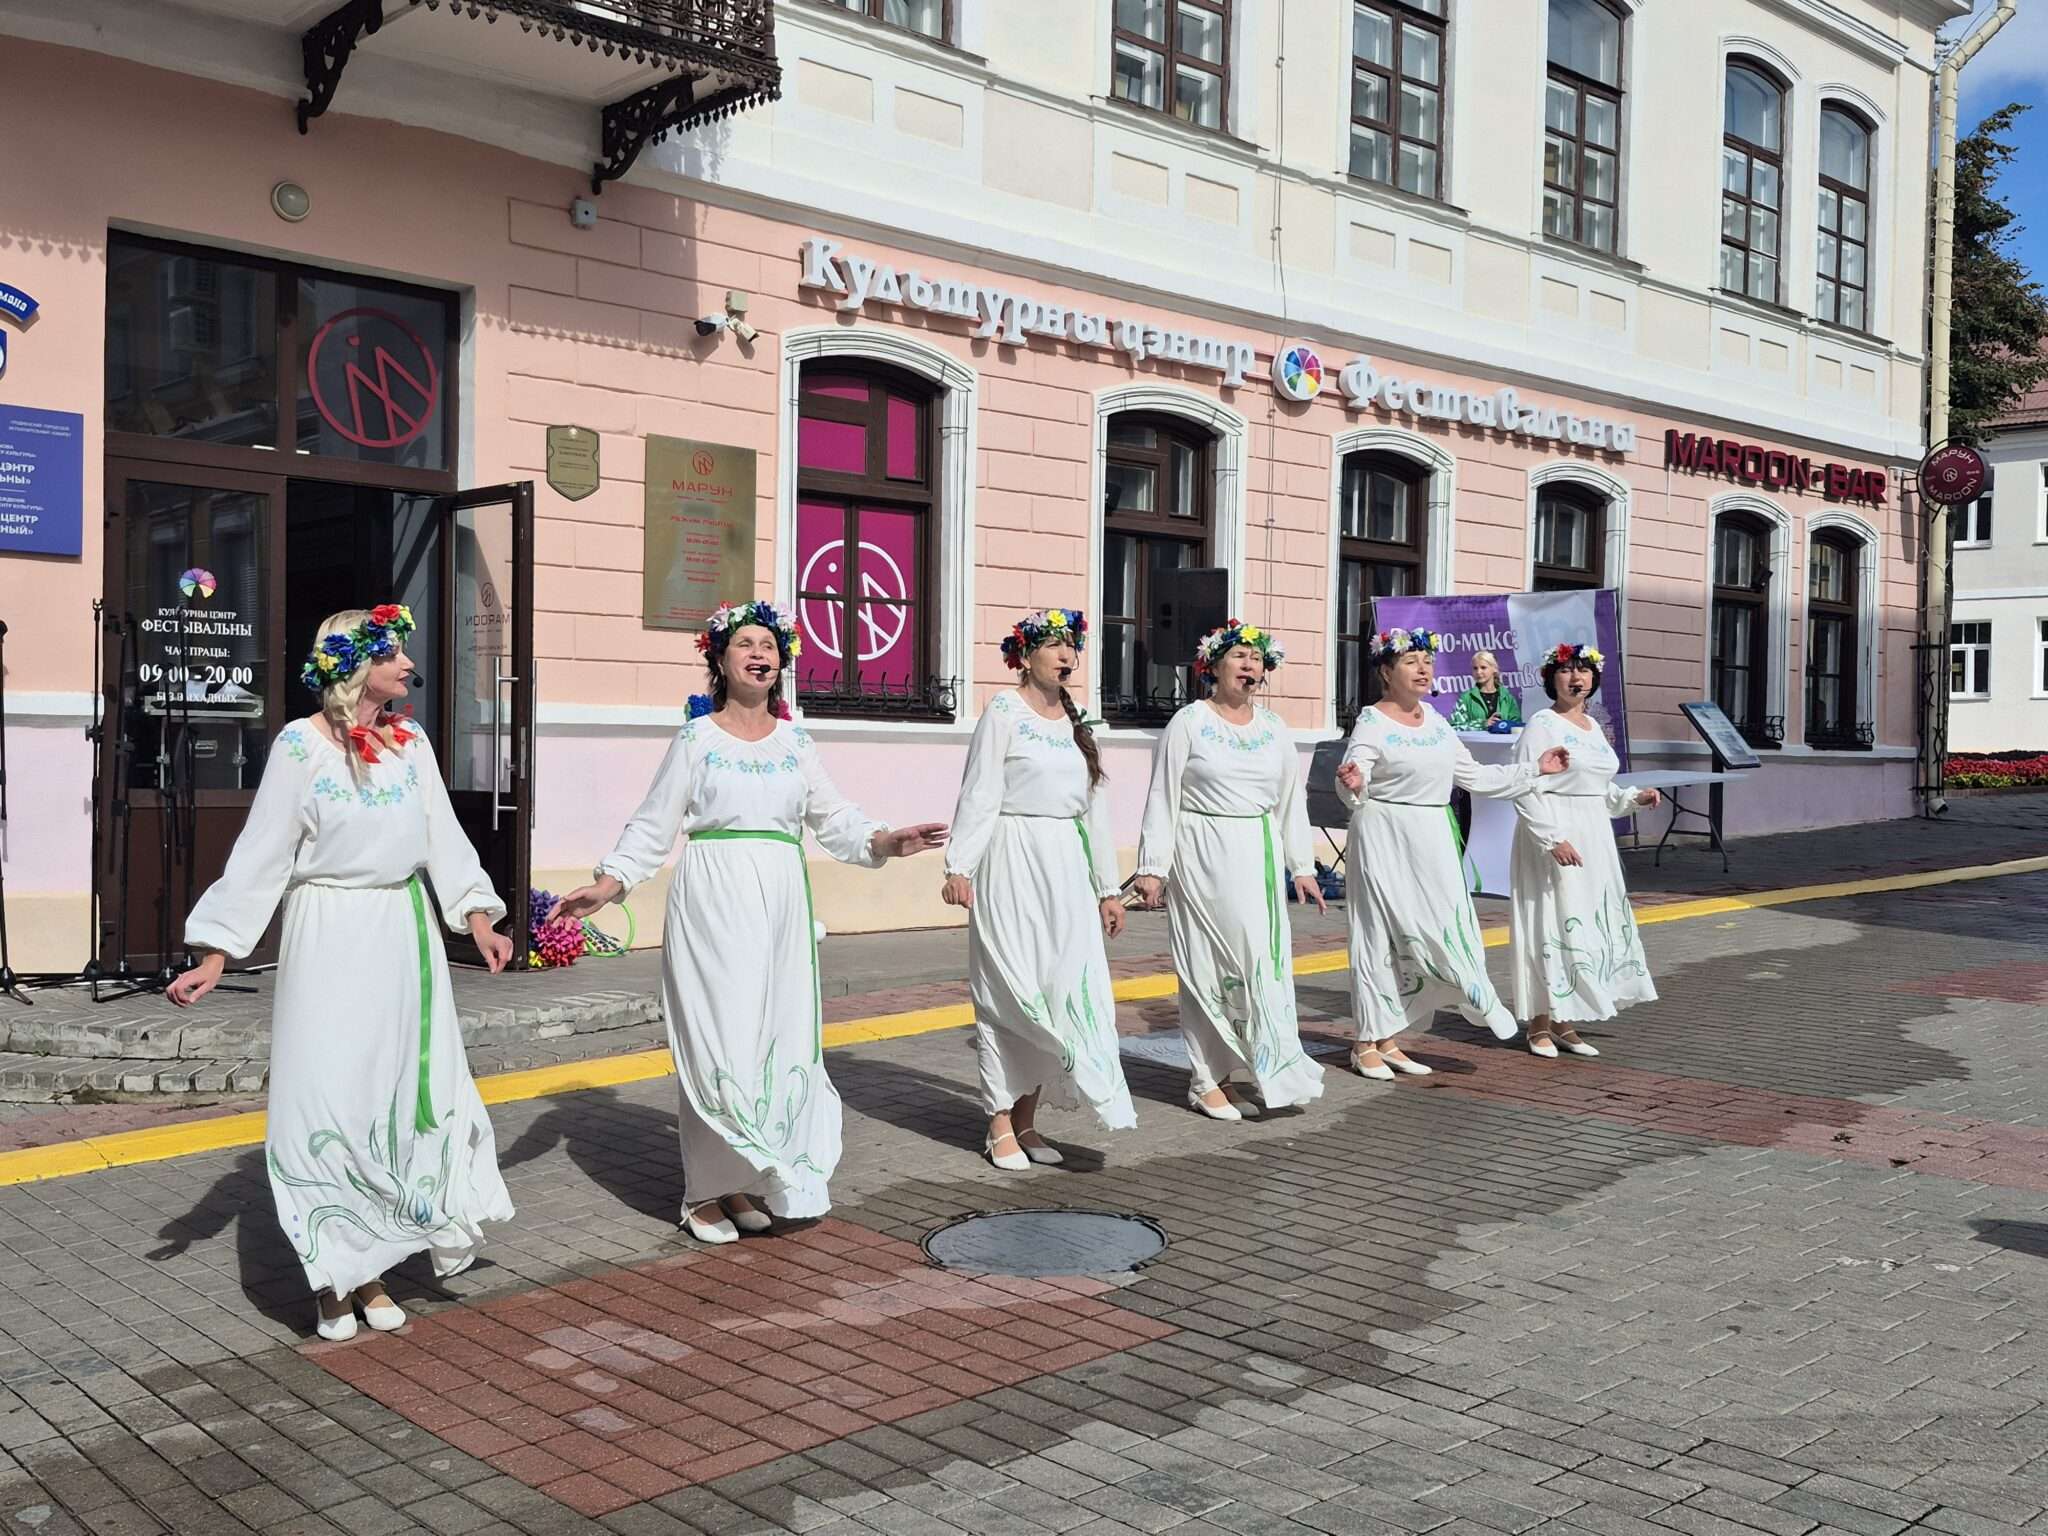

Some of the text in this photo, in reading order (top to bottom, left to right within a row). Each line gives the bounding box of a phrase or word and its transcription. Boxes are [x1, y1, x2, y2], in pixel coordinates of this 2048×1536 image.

[799, 238, 1636, 452] Культурны цэнтр Фестывальны
[672, 479, 734, 496] МАРУН
[0, 513, 39, 524] ЦЕНТР
[158, 607, 208, 619] КУЛУРНЫ
